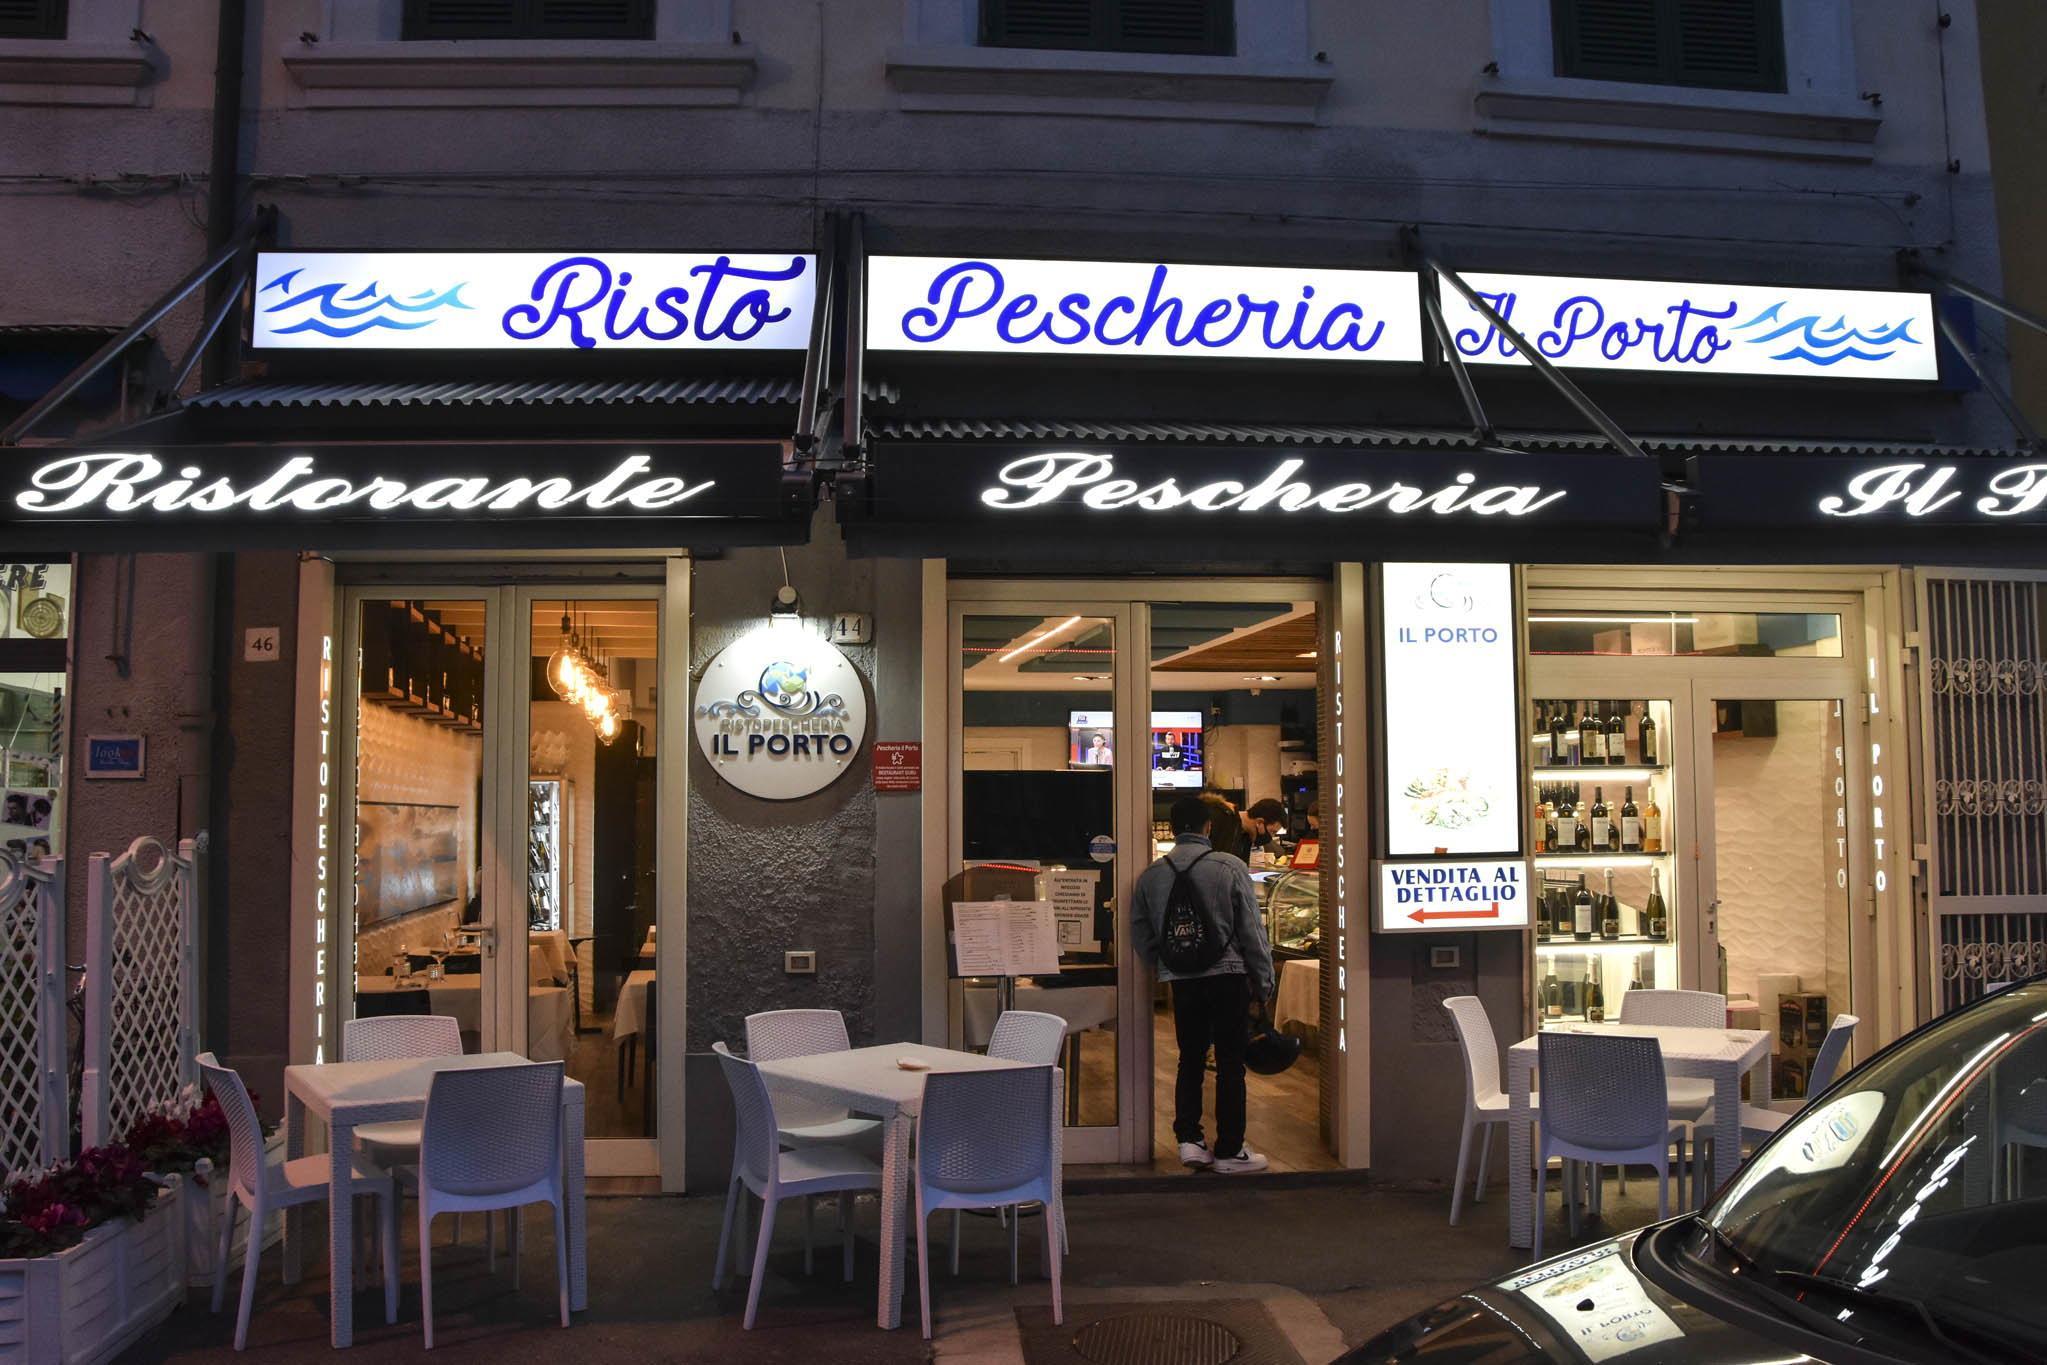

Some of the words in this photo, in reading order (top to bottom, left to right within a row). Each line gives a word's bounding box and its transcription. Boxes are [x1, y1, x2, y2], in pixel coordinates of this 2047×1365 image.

[502, 256, 807, 348] Risto
[902, 261, 1384, 352] Pescheria
[1537, 295, 1738, 364] Porto
[16, 451, 717, 512] Ristorante
[982, 452, 1567, 516] Pescheria
[1819, 463, 1962, 517] Il
[252, 637, 273, 651] 46
[836, 617, 862, 636] 44
[1399, 627, 1417, 643] IL
[1425, 627, 1498, 643] PORTO
[713, 734, 739, 755] IL
[749, 734, 852, 756] PORTO
[1335, 630, 1346, 1052] RISTOPESCHERIA
[1872, 743, 1886, 891] PORTO
[316, 636, 331, 1065] RISTOPESCHERIA
[1391, 868, 1481, 885] VENDITA
[1494, 867, 1520, 882] AL
[1397, 885, 1516, 903] DETTAGLIO
